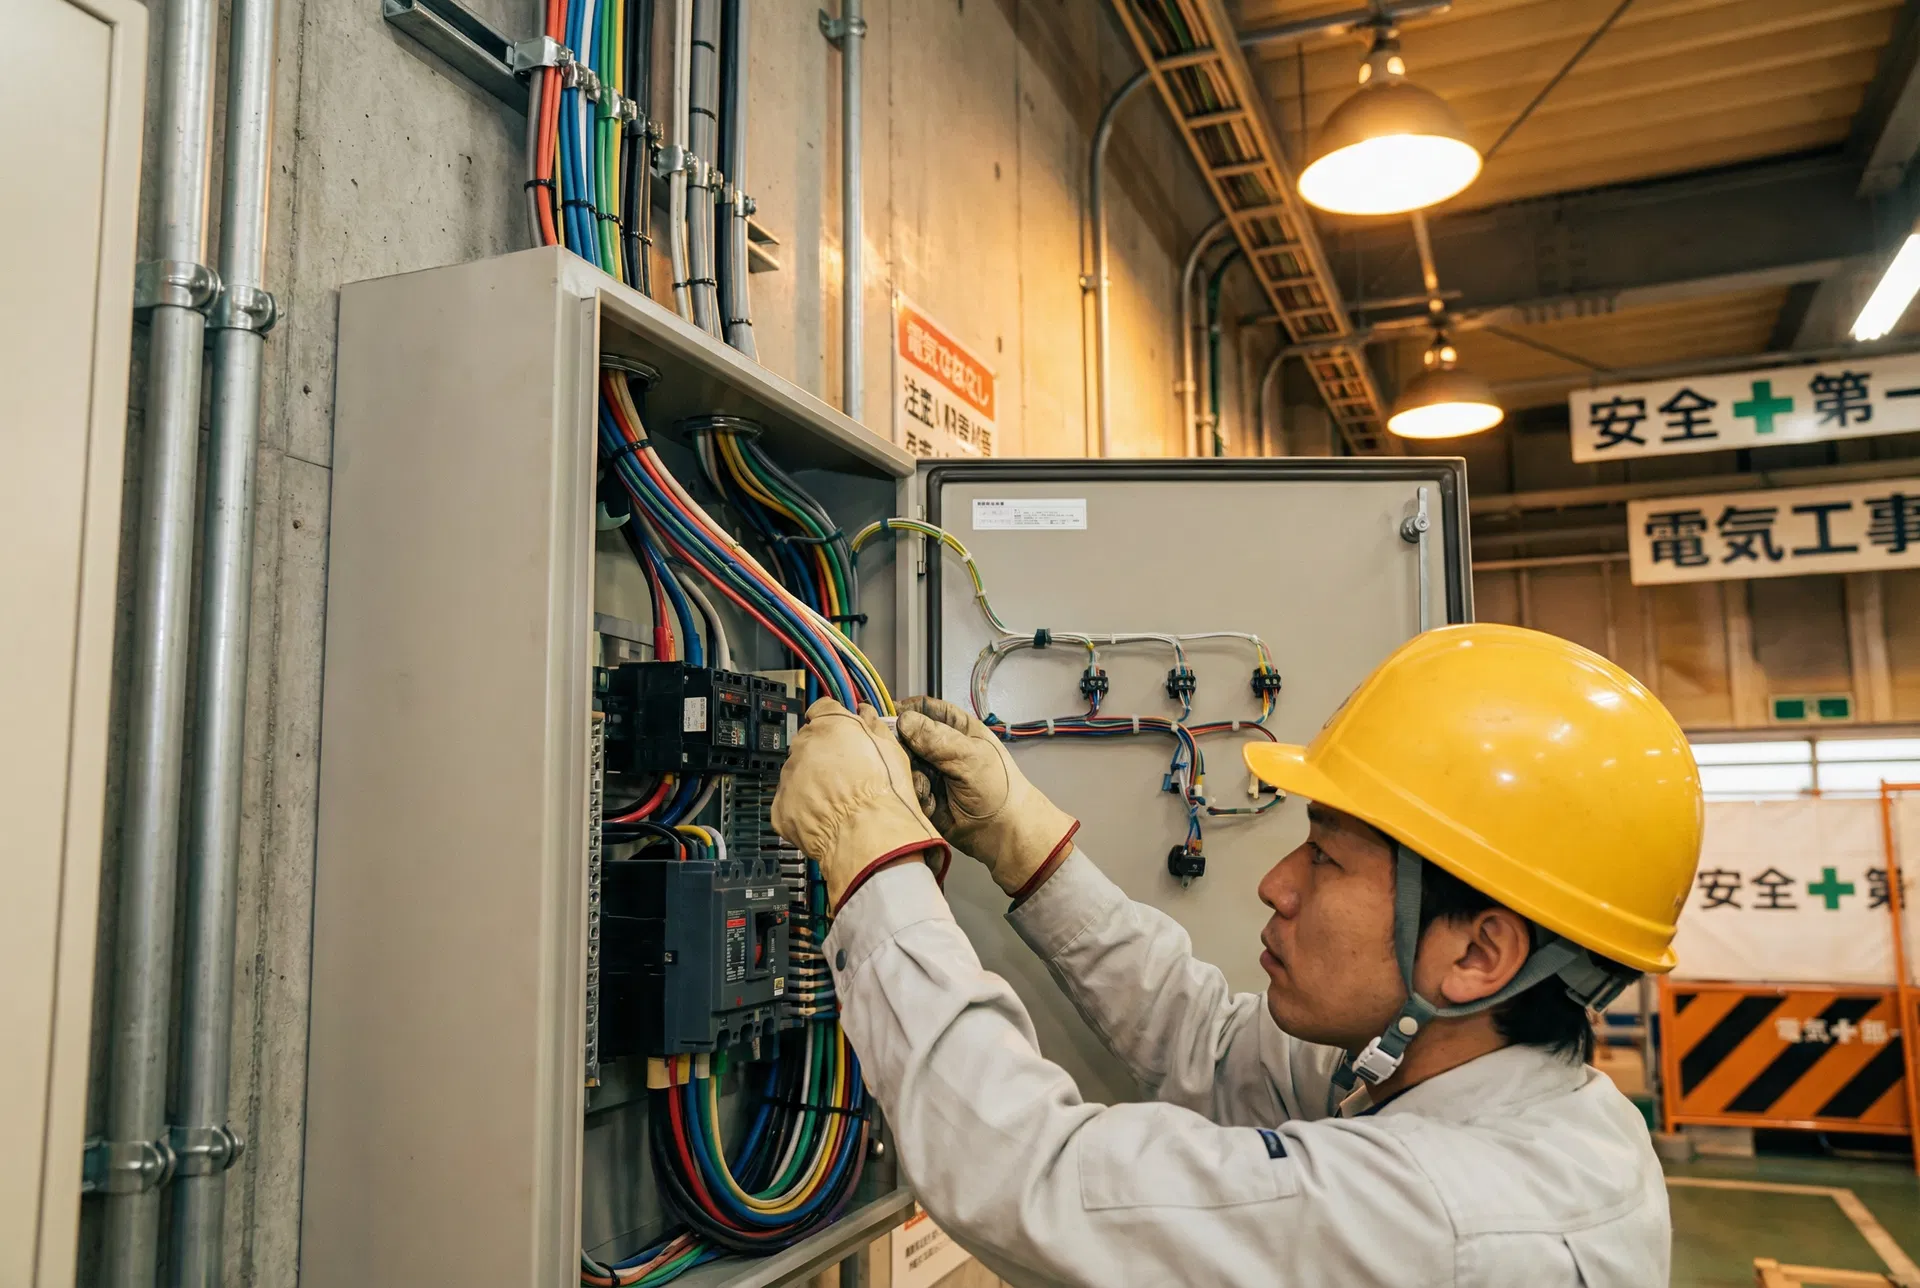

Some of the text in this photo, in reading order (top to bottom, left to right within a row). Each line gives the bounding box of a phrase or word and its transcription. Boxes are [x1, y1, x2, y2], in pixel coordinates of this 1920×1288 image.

[1590, 370, 1920, 450] 安全 第一
[1644, 492, 1920, 568] 電気工事
[1697, 867, 1797, 910] 安全
